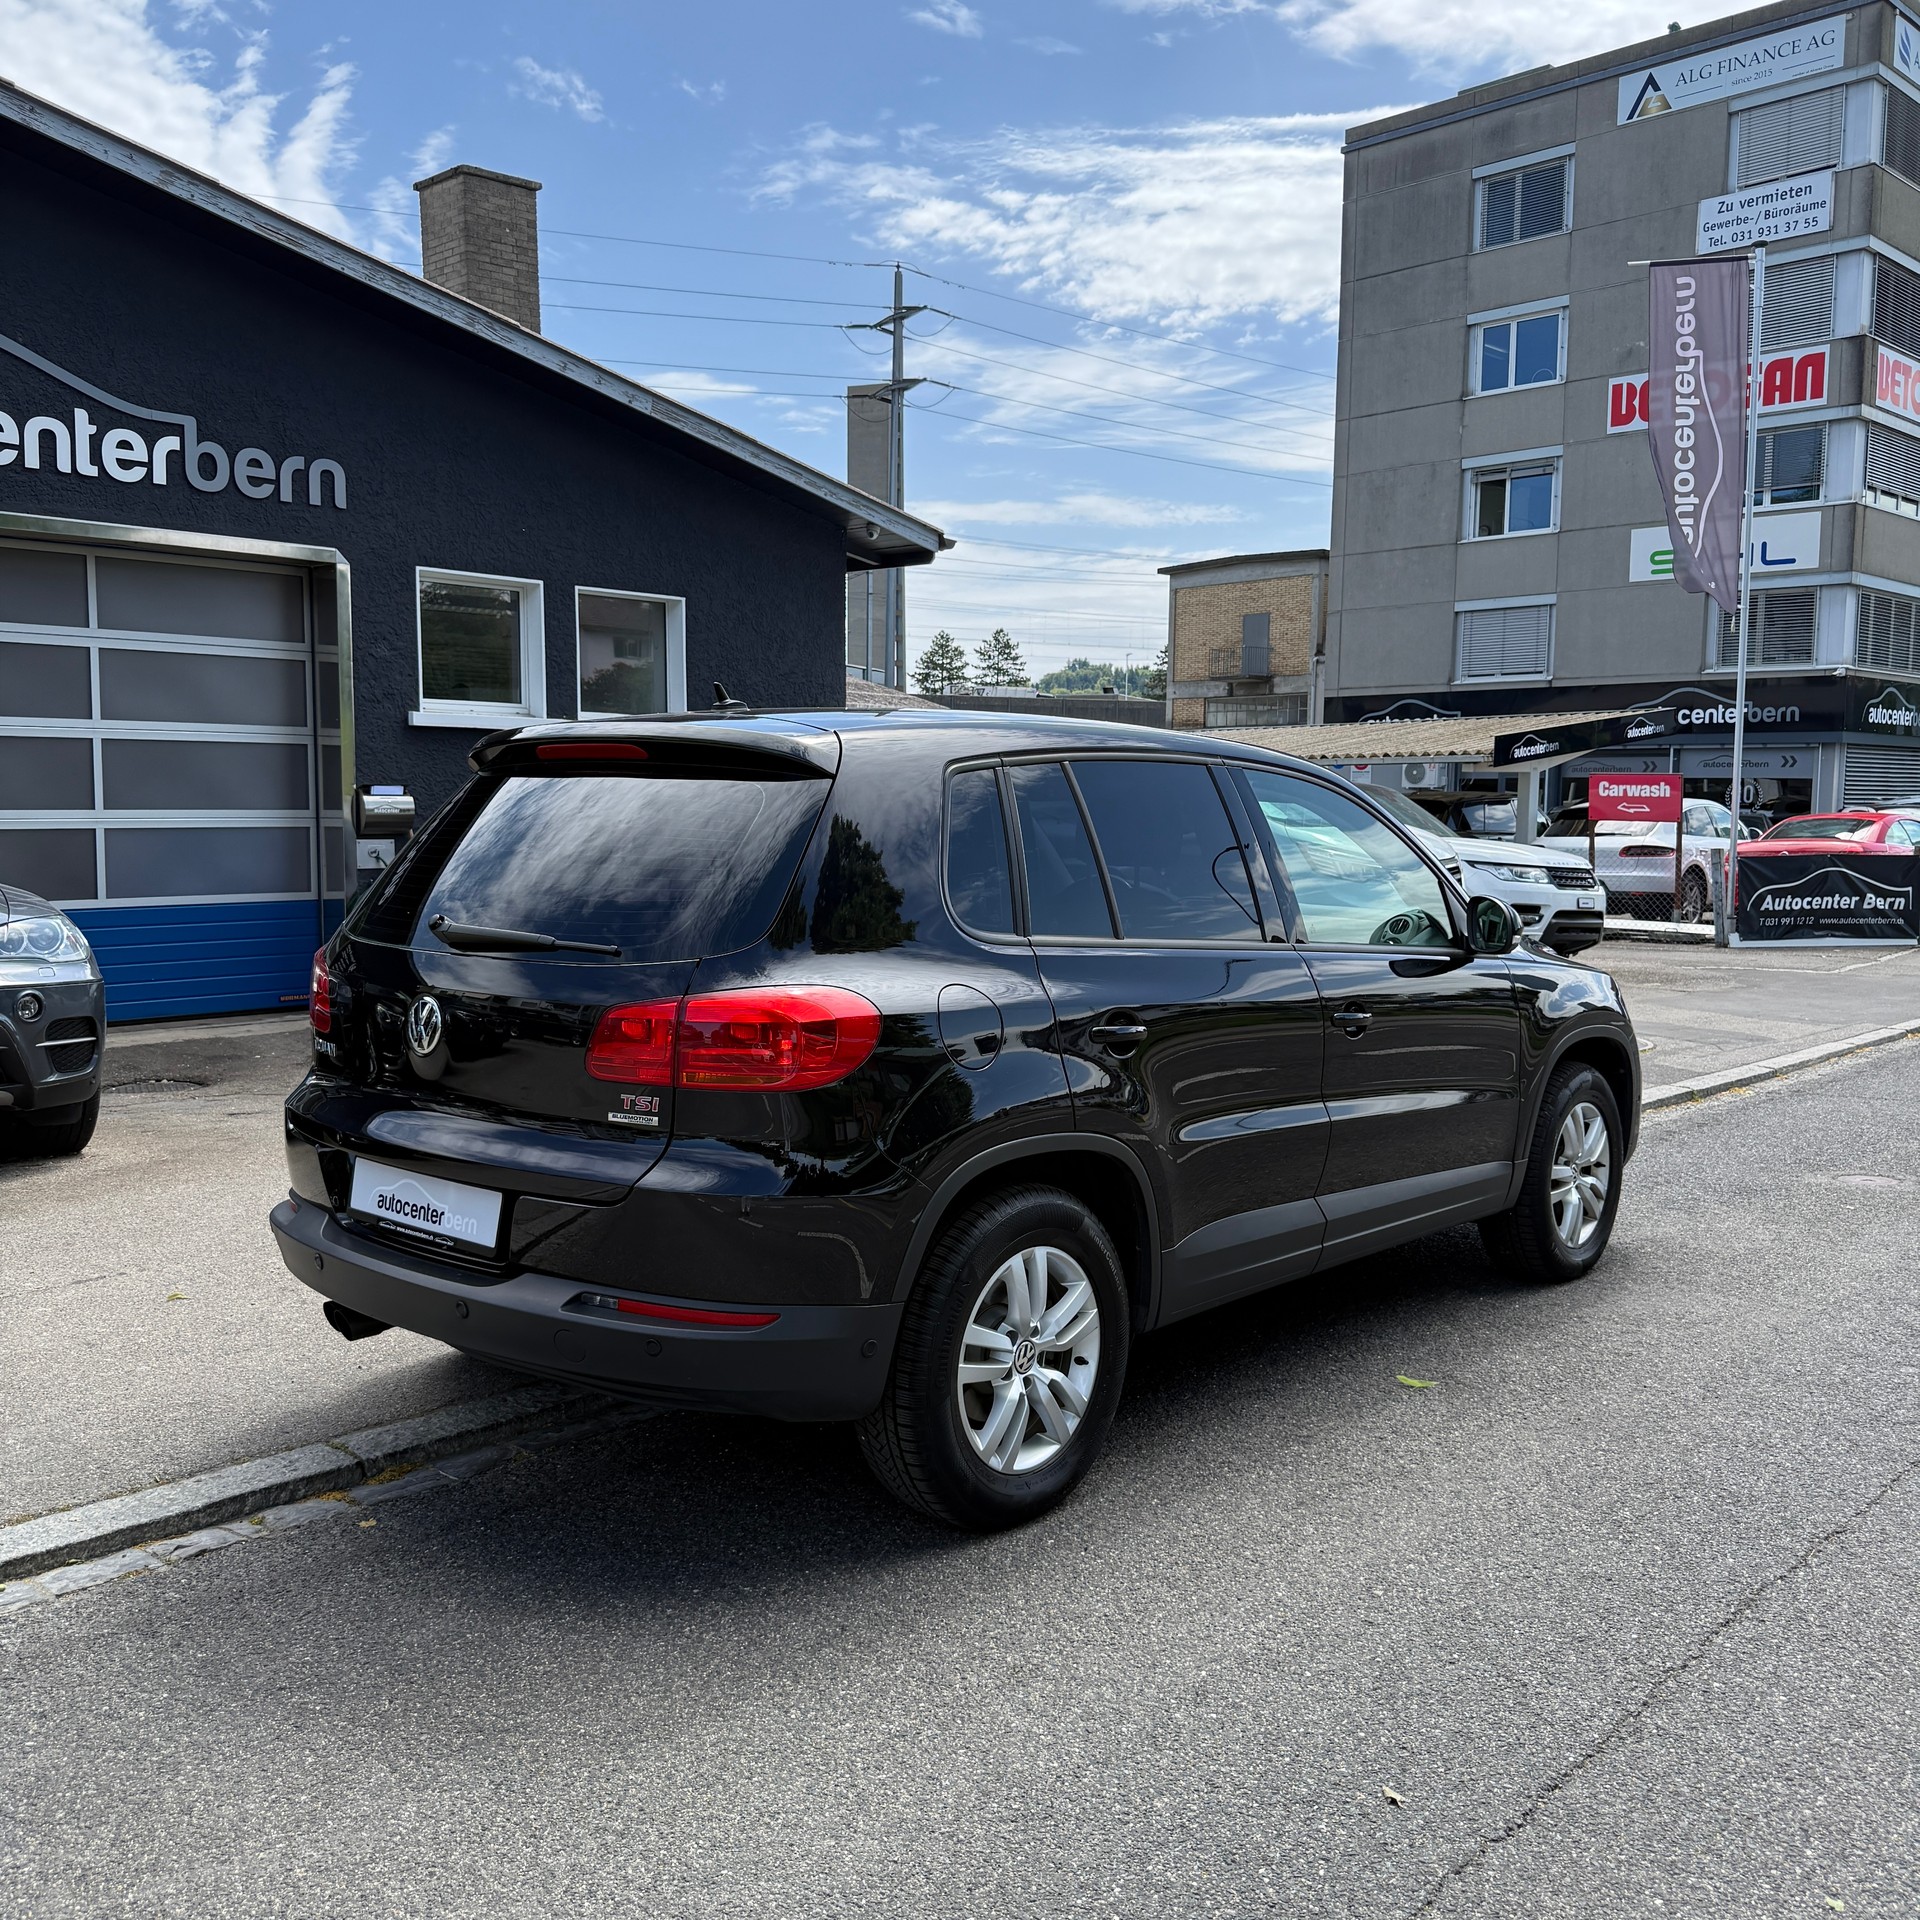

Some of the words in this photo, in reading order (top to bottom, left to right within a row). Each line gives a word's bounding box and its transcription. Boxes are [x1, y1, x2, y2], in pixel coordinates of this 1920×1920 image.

[1675, 64, 1712, 87] ALG
[1716, 38, 1802, 76] FINANCE
[1806, 29, 1836, 51] AG
[1731, 75, 1752, 86] since
[1753, 68, 1773, 81] 2015
[1717, 201, 1734, 214] Zu
[1739, 184, 1813, 210] vermieten
[1764, 199, 1827, 221] Büroräume
[1708, 235, 1727, 248] Tel.
[1731, 229, 1753, 243] 031
[1757, 224, 1779, 238] 931
[1783, 219, 1799, 233] 37
[1803, 215, 1819, 229] 55
[1627, 724, 1665, 739] autocenterbern
[1513, 741, 1560, 759] autocenterbern
[1702, 760, 1769, 769] autoceerbern
[1598, 780, 1671, 797] Carwash
[1760, 893, 1860, 911] Autocenter
[1863, 892, 1905, 911] Bern
[1765, 917, 1778, 926] 031
[1780, 916, 1794, 926] 991
[1819, 916, 1905, 926] www.autocenterbern.ch
[620, 1093, 660, 1113] TSI
[611, 1113, 654, 1123] BLUEMOTION
[377, 1193, 478, 1236] autocenterbern
